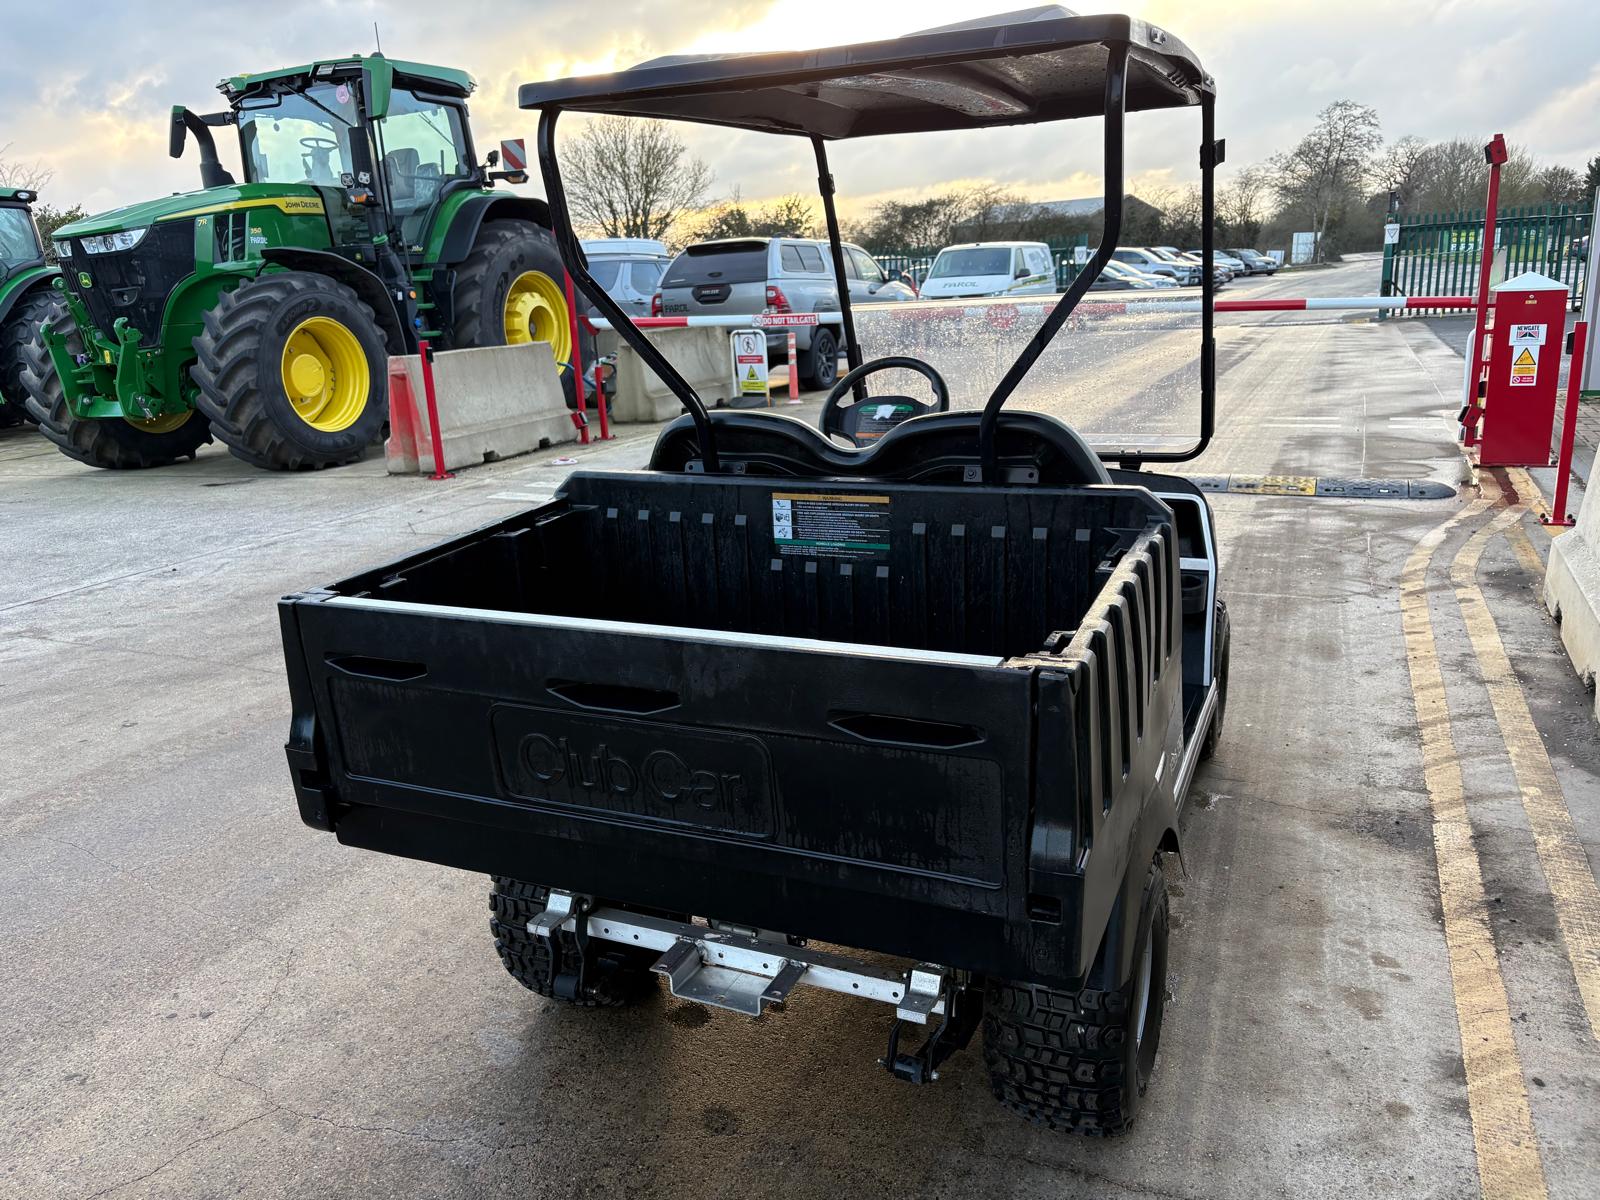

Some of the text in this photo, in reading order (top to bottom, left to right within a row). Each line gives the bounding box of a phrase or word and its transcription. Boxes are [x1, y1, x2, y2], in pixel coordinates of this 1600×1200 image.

[285, 200, 321, 209] JOHN DEERE
[197, 217, 208, 227] 7R
[942, 281, 979, 289] FAROL
[664, 303, 691, 313] FAROL
[763, 315, 816, 325] DO NOT TAILGATE
